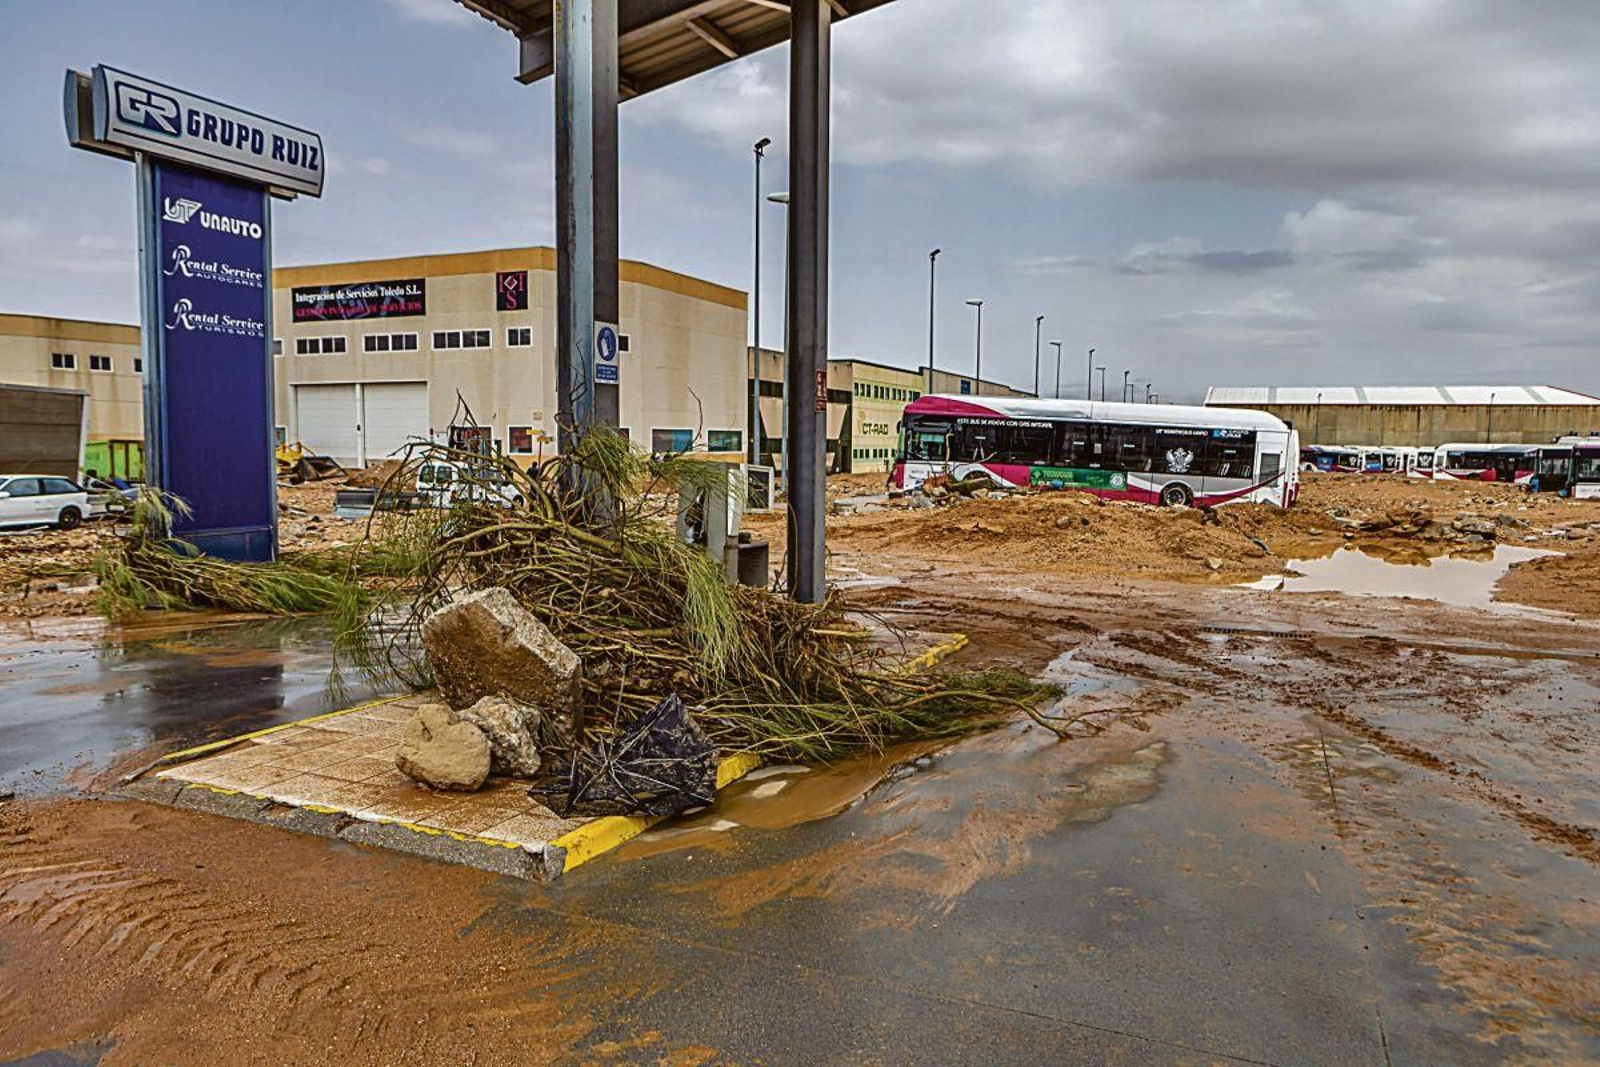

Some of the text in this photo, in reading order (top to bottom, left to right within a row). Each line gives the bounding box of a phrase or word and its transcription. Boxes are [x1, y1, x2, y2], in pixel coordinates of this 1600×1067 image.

[187, 109, 318, 171] GRUPO RUIZ
[200, 211, 262, 239] UNAUTO
[163, 245, 263, 281] Rental Service
[195, 273, 263, 288] AUTOCARES
[335, 289, 345, 300] de
[346, 287, 378, 299] Servicios
[380, 287, 405, 297] Toledo
[165, 298, 264, 330] Rental Service
[198, 324, 264, 337] TURISMOS
